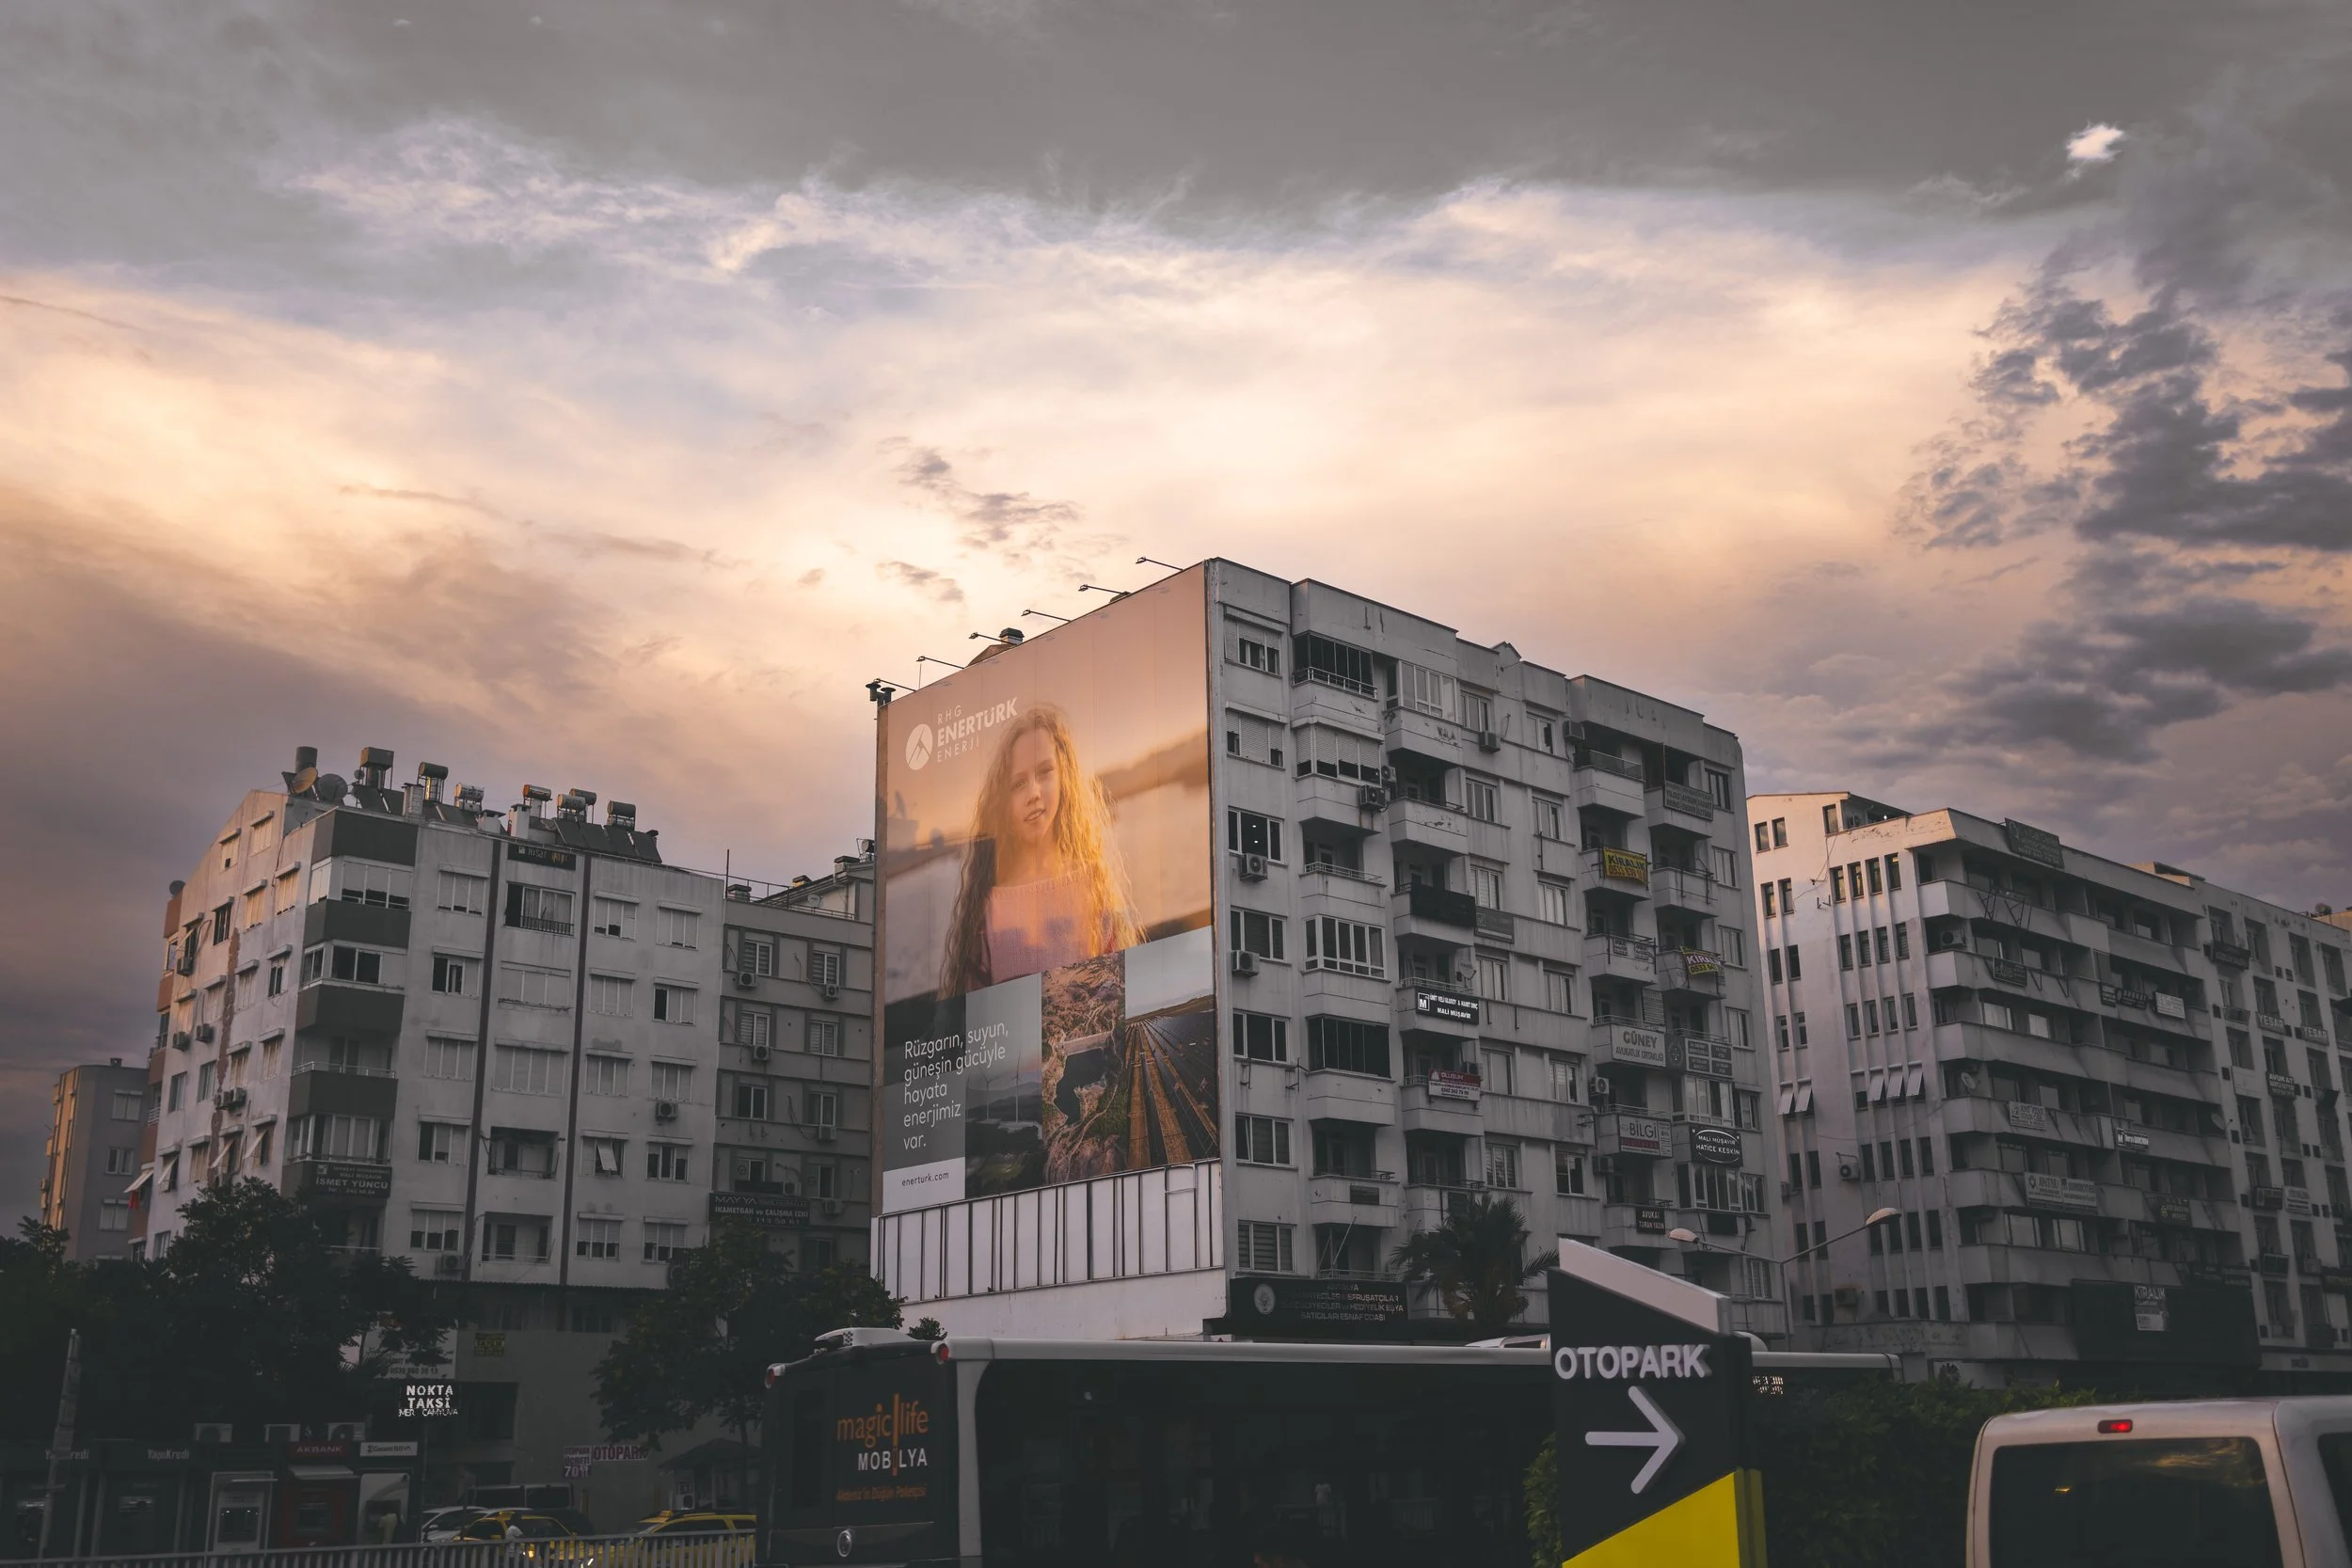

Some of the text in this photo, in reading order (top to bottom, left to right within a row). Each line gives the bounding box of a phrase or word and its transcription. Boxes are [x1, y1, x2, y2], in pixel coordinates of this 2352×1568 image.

[937, 705, 962, 725] RHG
[937, 697, 1019, 747] ENERTÜRK
[1437, 1006, 1450, 1016] MALİ
[904, 1022, 1009, 1060] Rüzgarın, suyun,
[1623, 1031, 1658, 1050] GÜNEY
[1615, 1047, 1641, 1058] AVUKATLIK
[904, 1043, 1006, 1087] güneşin gücüyle
[904, 1082, 947, 1107] hayata
[903, 1100, 961, 1128] enerjimiz
[1629, 1120, 1658, 1139] BİLGİ
[903, 1132, 927, 1150] var.
[1712, 1136, 1736, 1145] MÜŞAVİR
[1696, 1143, 1740, 1155] HATİCE KESKİN
[315, 1176, 389, 1189] İSMET YÜNCÜ
[901, 1171, 949, 1187] enerturk.com
[1340, 1312, 1364, 1322] ESNAF
[1554, 1344, 1712, 1380] OTOPARK
[405, 1385, 453, 1396] NOKTA
[407, 1395, 451, 1409] TAKSİ
[836, 1400, 930, 1449] magic life
[146, 1448, 191, 1462] YapıKredi
[295, 1446, 343, 1454] AKBANK
[594, 1446, 648, 1461] OTOPARK
